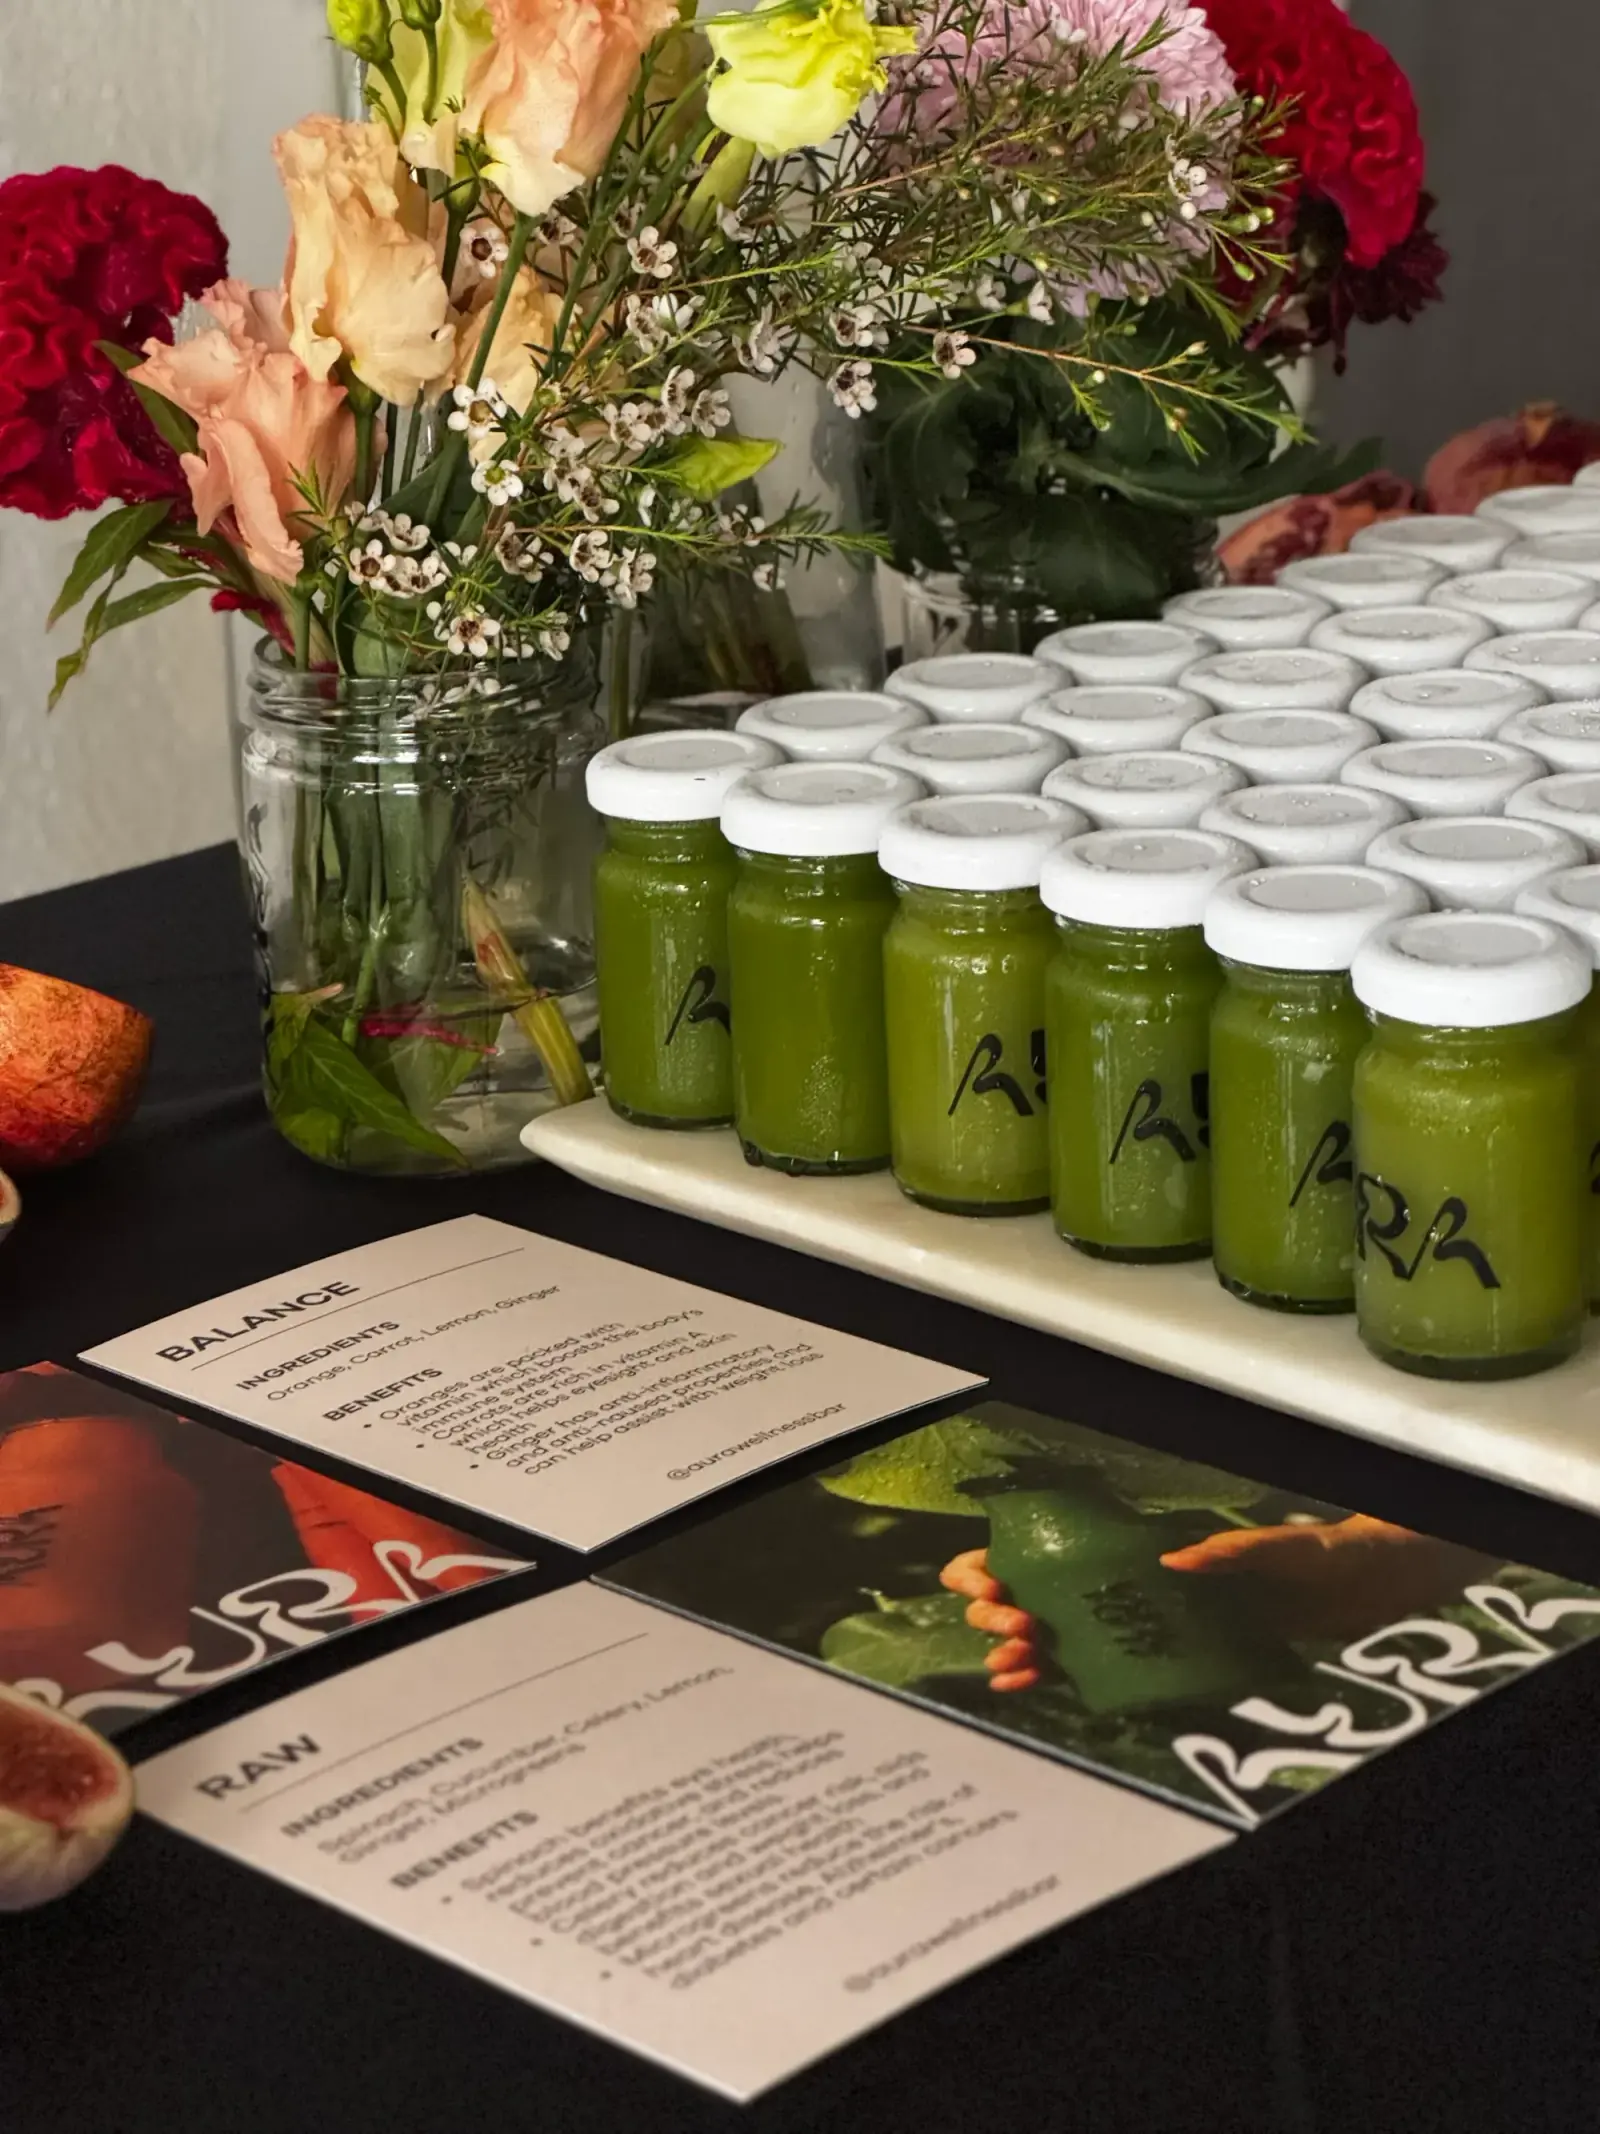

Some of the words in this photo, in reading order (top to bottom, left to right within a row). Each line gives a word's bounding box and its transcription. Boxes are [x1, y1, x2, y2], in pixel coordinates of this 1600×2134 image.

[155, 1281, 360, 1362] BALANCE
[236, 1322, 400, 1390] INGREDIENTS
[267, 1366, 352, 1401] Orange,
[349, 1336, 425, 1364] Carrot,
[420, 1309, 498, 1336] Lemon,
[495, 1285, 560, 1309] Ginger
[397, 1392, 477, 1426] vitamin
[475, 1367, 539, 1393] which
[533, 1341, 605, 1369] boosts
[602, 1329, 639, 1343] the
[636, 1310, 704, 1331] body's
[322, 1368, 443, 1421] BENEFITS
[379, 1381, 469, 1420] Oranges
[469, 1366, 505, 1382] are
[505, 1337, 580, 1370] packed
[580, 1323, 624, 1339] with
[412, 1396, 500, 1434] immune
[500, 1366, 573, 1397] system
[432, 1404, 513, 1440] Carrots
[513, 1389, 550, 1405] are
[549, 1372, 592, 1390] rich
[587, 1364, 614, 1374] in
[612, 1337, 688, 1365] vitamin
[688, 1331, 706, 1339] A
[450, 1418, 514, 1447] which
[509, 1394, 571, 1420] helps
[570, 1361, 656, 1395] eyesight
[654, 1345, 695, 1362] and
[695, 1334, 737, 1349] skin
[486, 1427, 556, 1460] Ginger
[554, 1410, 599, 1429] has
[599, 1344, 775, 1412] anti-inflammatory
[506, 1445, 549, 1467] and
[549, 1394, 672, 1448] anti-nausea
[671, 1358, 773, 1398] properties
[773, 1343, 813, 1359] and
[524, 1454, 567, 1475] can
[562, 1433, 613, 1455] help
[613, 1407, 675, 1434] assist
[671, 1390, 718, 1408] with
[716, 1365, 786, 1391] weight
[779, 1353, 824, 1368] loss
[465, 1423, 537, 1455] health
[667, 1403, 846, 1480] @aurawellnessbar
[196, 1734, 320, 1799] RAW
[281, 1738, 484, 1838] INGREDIENTS
[389, 1812, 538, 1890] BENEFITS
